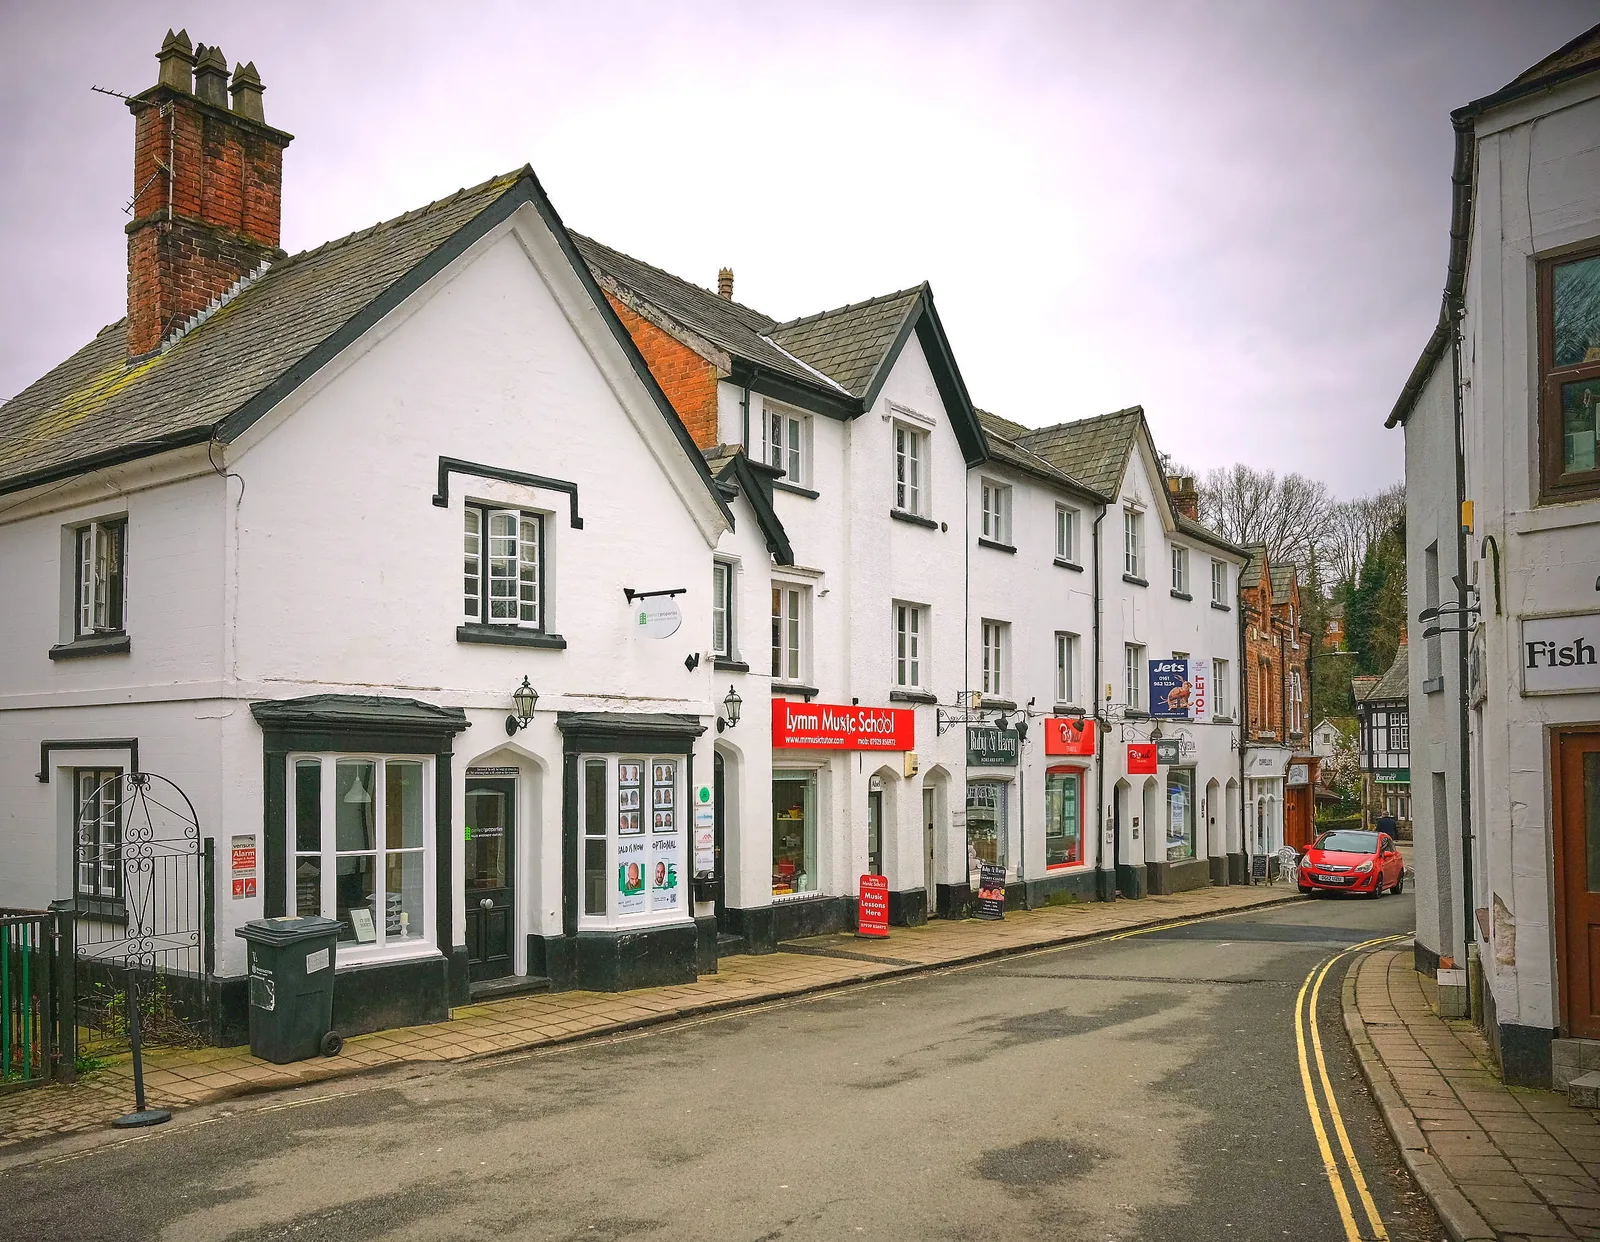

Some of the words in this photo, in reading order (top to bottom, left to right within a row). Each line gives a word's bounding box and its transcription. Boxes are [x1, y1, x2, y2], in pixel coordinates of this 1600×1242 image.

[1525, 637, 1597, 669] Fish
[1153, 662, 1185, 673] Jets
[1195, 675, 1205, 697] LET
[1195, 698, 1205, 715] TO
[786, 707, 819, 732] Lymm
[822, 708, 856, 735] Music
[858, 710, 895, 734] School
[970, 730, 987, 757] Ruby
[989, 730, 996, 753] &
[997, 731, 1016, 757] Harry
[652, 840, 677, 851] OPTIONAL
[864, 892, 883, 901] Music
[861, 900, 886, 909] Lessons
[865, 908, 882, 917] Here
